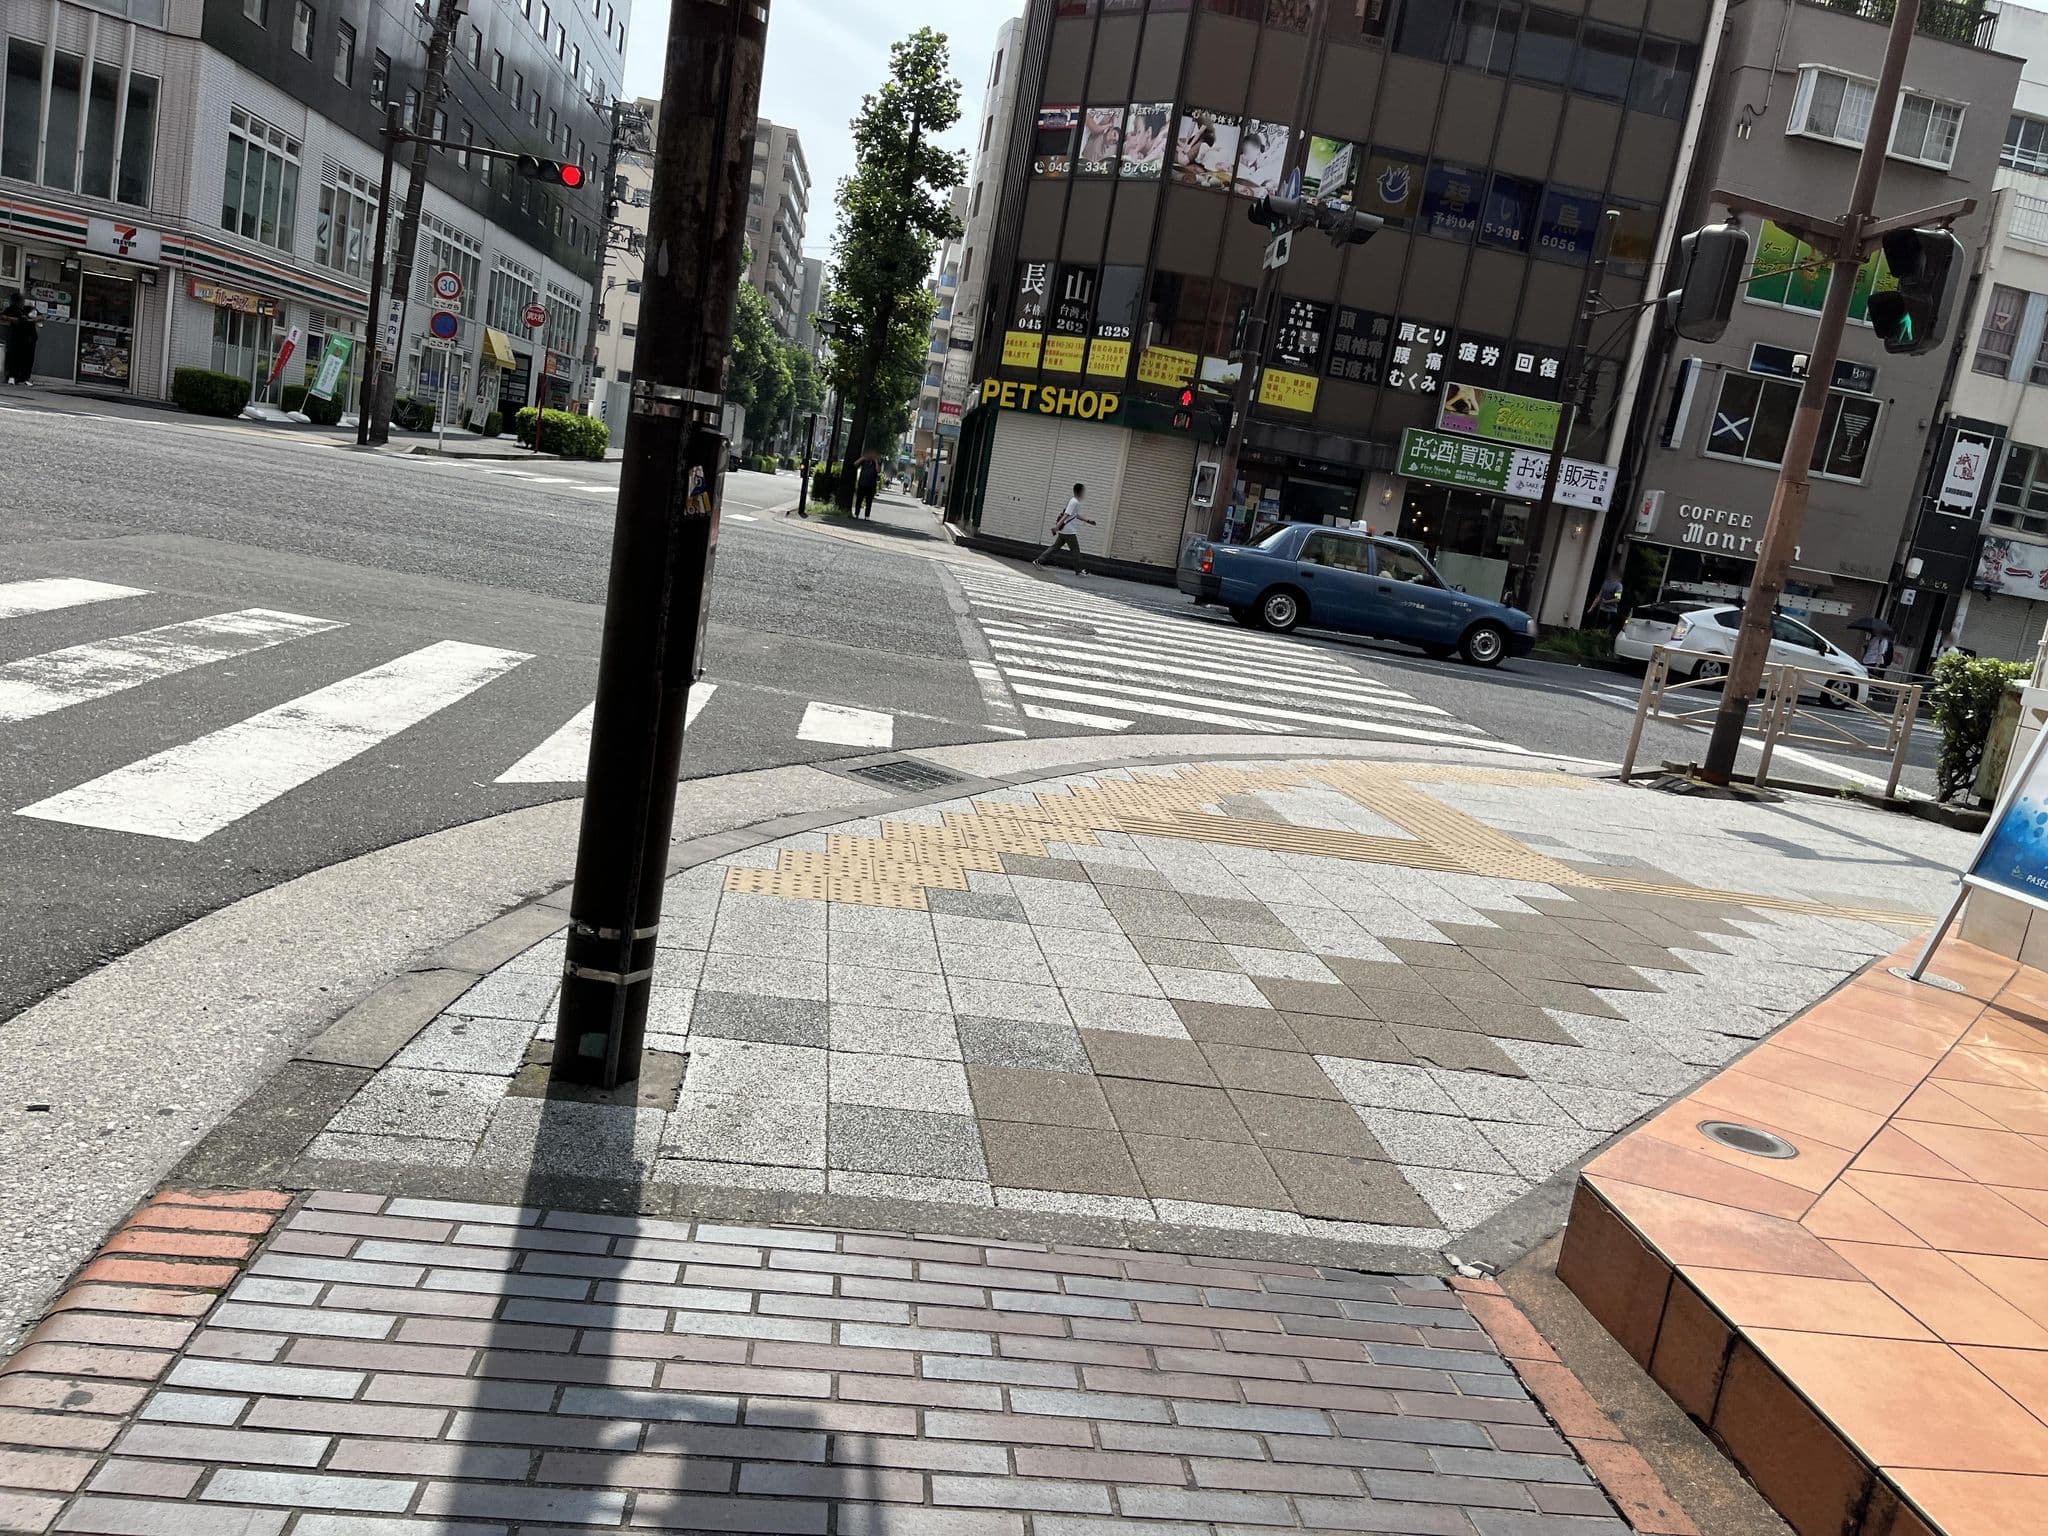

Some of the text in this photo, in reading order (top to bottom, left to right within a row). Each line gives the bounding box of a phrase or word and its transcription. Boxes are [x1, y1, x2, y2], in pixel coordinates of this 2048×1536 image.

[1085, 161, 1107, 172] 334
[1123, 161, 1157, 173] 8764
[440, 279, 456, 293] 30
[433, 300, 460, 310] ここから
[1018, 317, 1130, 338] 045 262 1328
[1398, 322, 1446, 347] 肩こり
[1393, 346, 1443, 371] 腰痛
[1458, 341, 1560, 379] 疲労 回復
[1389, 368, 1436, 392] むくみ
[981, 378, 1037, 410] PET
[1039, 385, 1119, 420] SHOP
[1410, 436, 1455, 463] お酒
[1459, 444, 1496, 471] 買取
[1562, 464, 1601, 490] 販売
[1680, 504, 1753, 528] COFFEE
